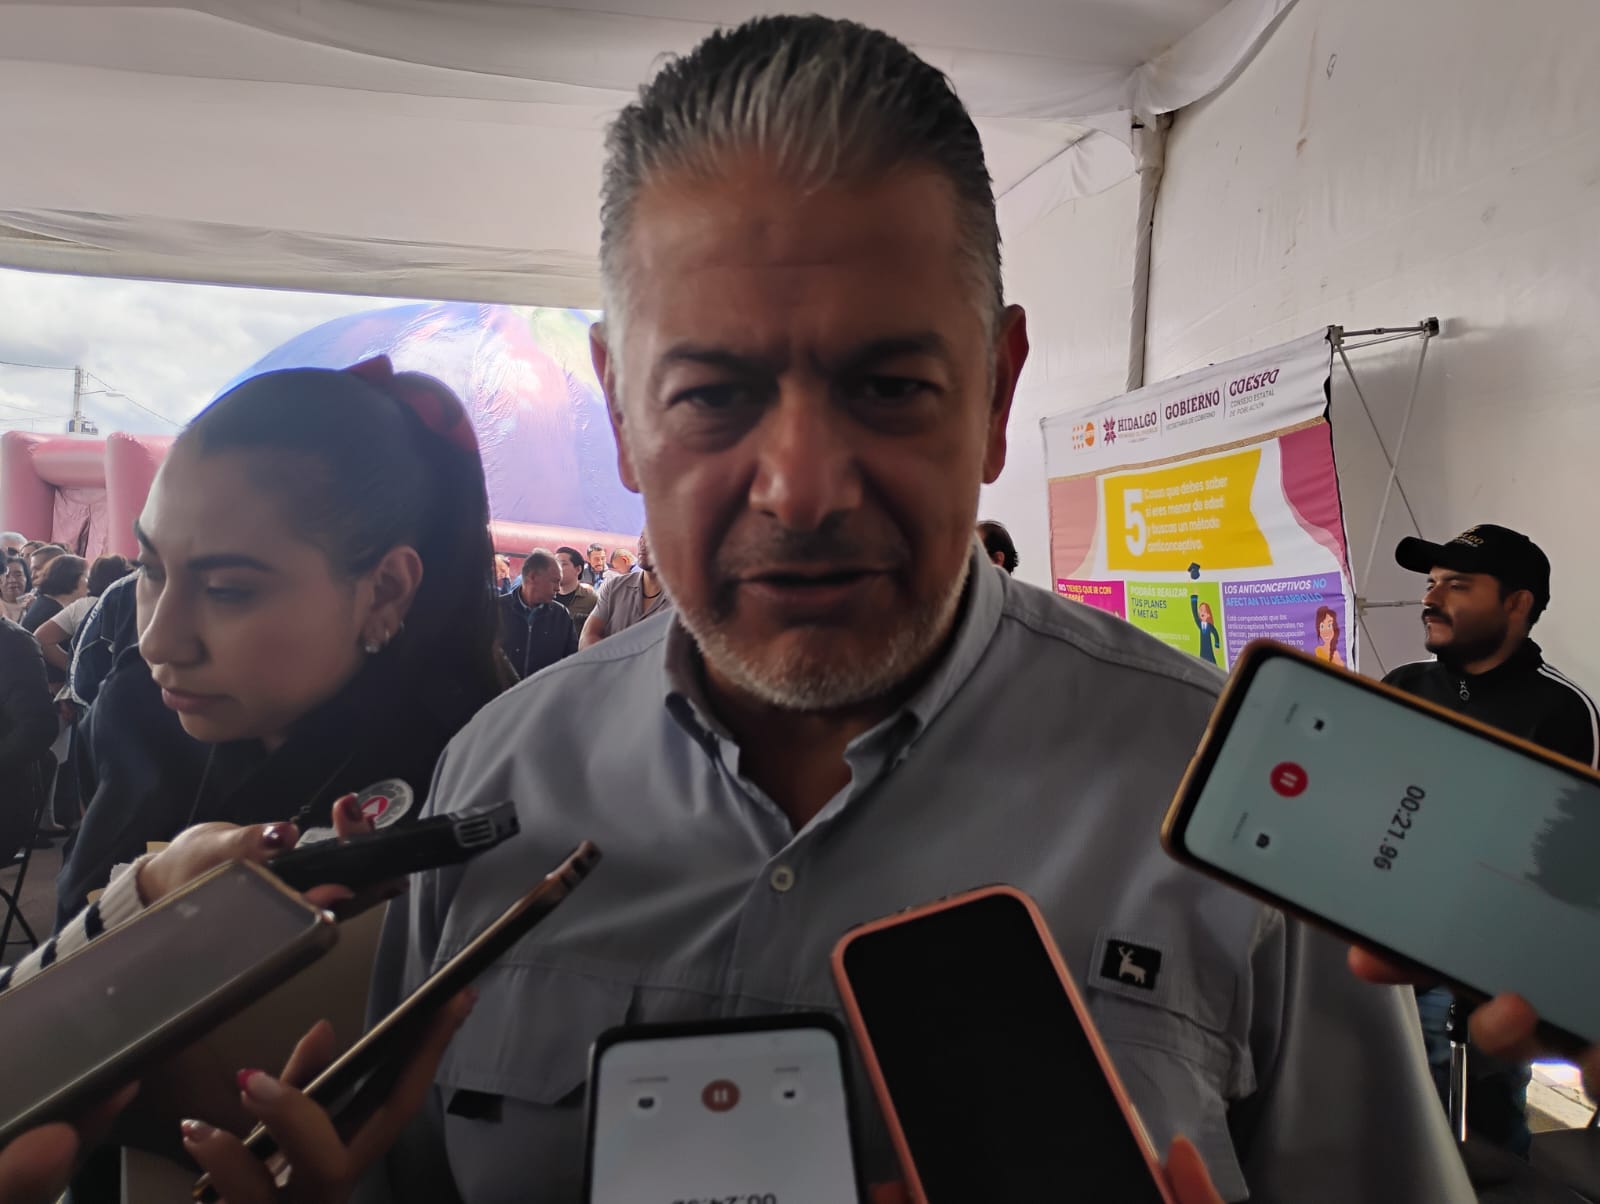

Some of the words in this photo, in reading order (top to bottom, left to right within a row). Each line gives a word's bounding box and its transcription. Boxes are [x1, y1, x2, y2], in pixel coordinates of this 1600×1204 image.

[1228, 368, 1280, 397] COESPO
[1165, 389, 1221, 420] GOBIERNO
[1117, 411, 1157, 433] HIDALGO
[1166, 486, 1180, 499] que
[1181, 480, 1204, 495] debes
[1206, 476, 1228, 491] saber
[1168, 502, 1192, 515] menor
[1193, 498, 1203, 511] de
[1123, 488, 1147, 557] 5
[1224, 584, 1238, 594] LOS
[1238, 579, 1312, 594] ANTICONCEPTIVOS
[1312, 577, 1327, 589] NO
[1131, 597, 1143, 608] TUS
[1143, 598, 1168, 609] PLANES
[1225, 596, 1260, 607] AFECTAN
[1260, 595, 1271, 606] TU
[1271, 592, 1324, 605] DESARROLLO
[1137, 609, 1159, 619] METAS
[1373, 784, 1426, 870] 00:21.96
